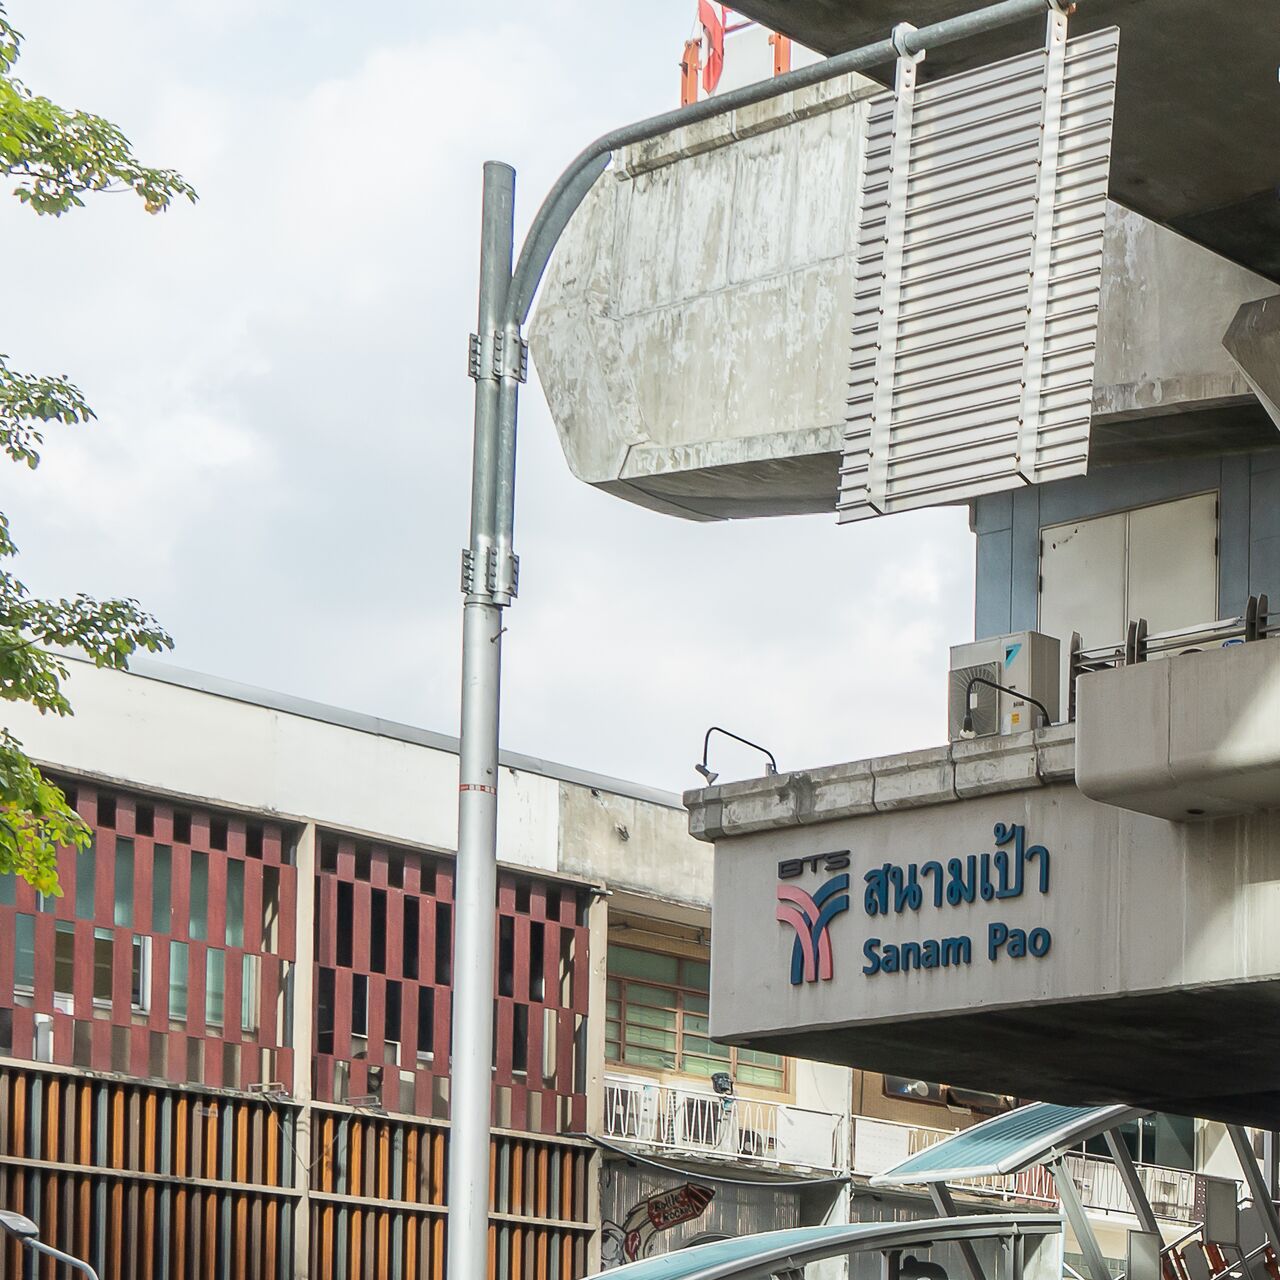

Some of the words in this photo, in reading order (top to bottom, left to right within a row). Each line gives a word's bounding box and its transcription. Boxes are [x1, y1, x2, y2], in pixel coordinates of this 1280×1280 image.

[778, 850, 850, 880] BTS
[864, 823, 1050, 916] สนามเป้า
[862, 936, 972, 976] Sanam
[988, 922, 1051, 961] Pao
